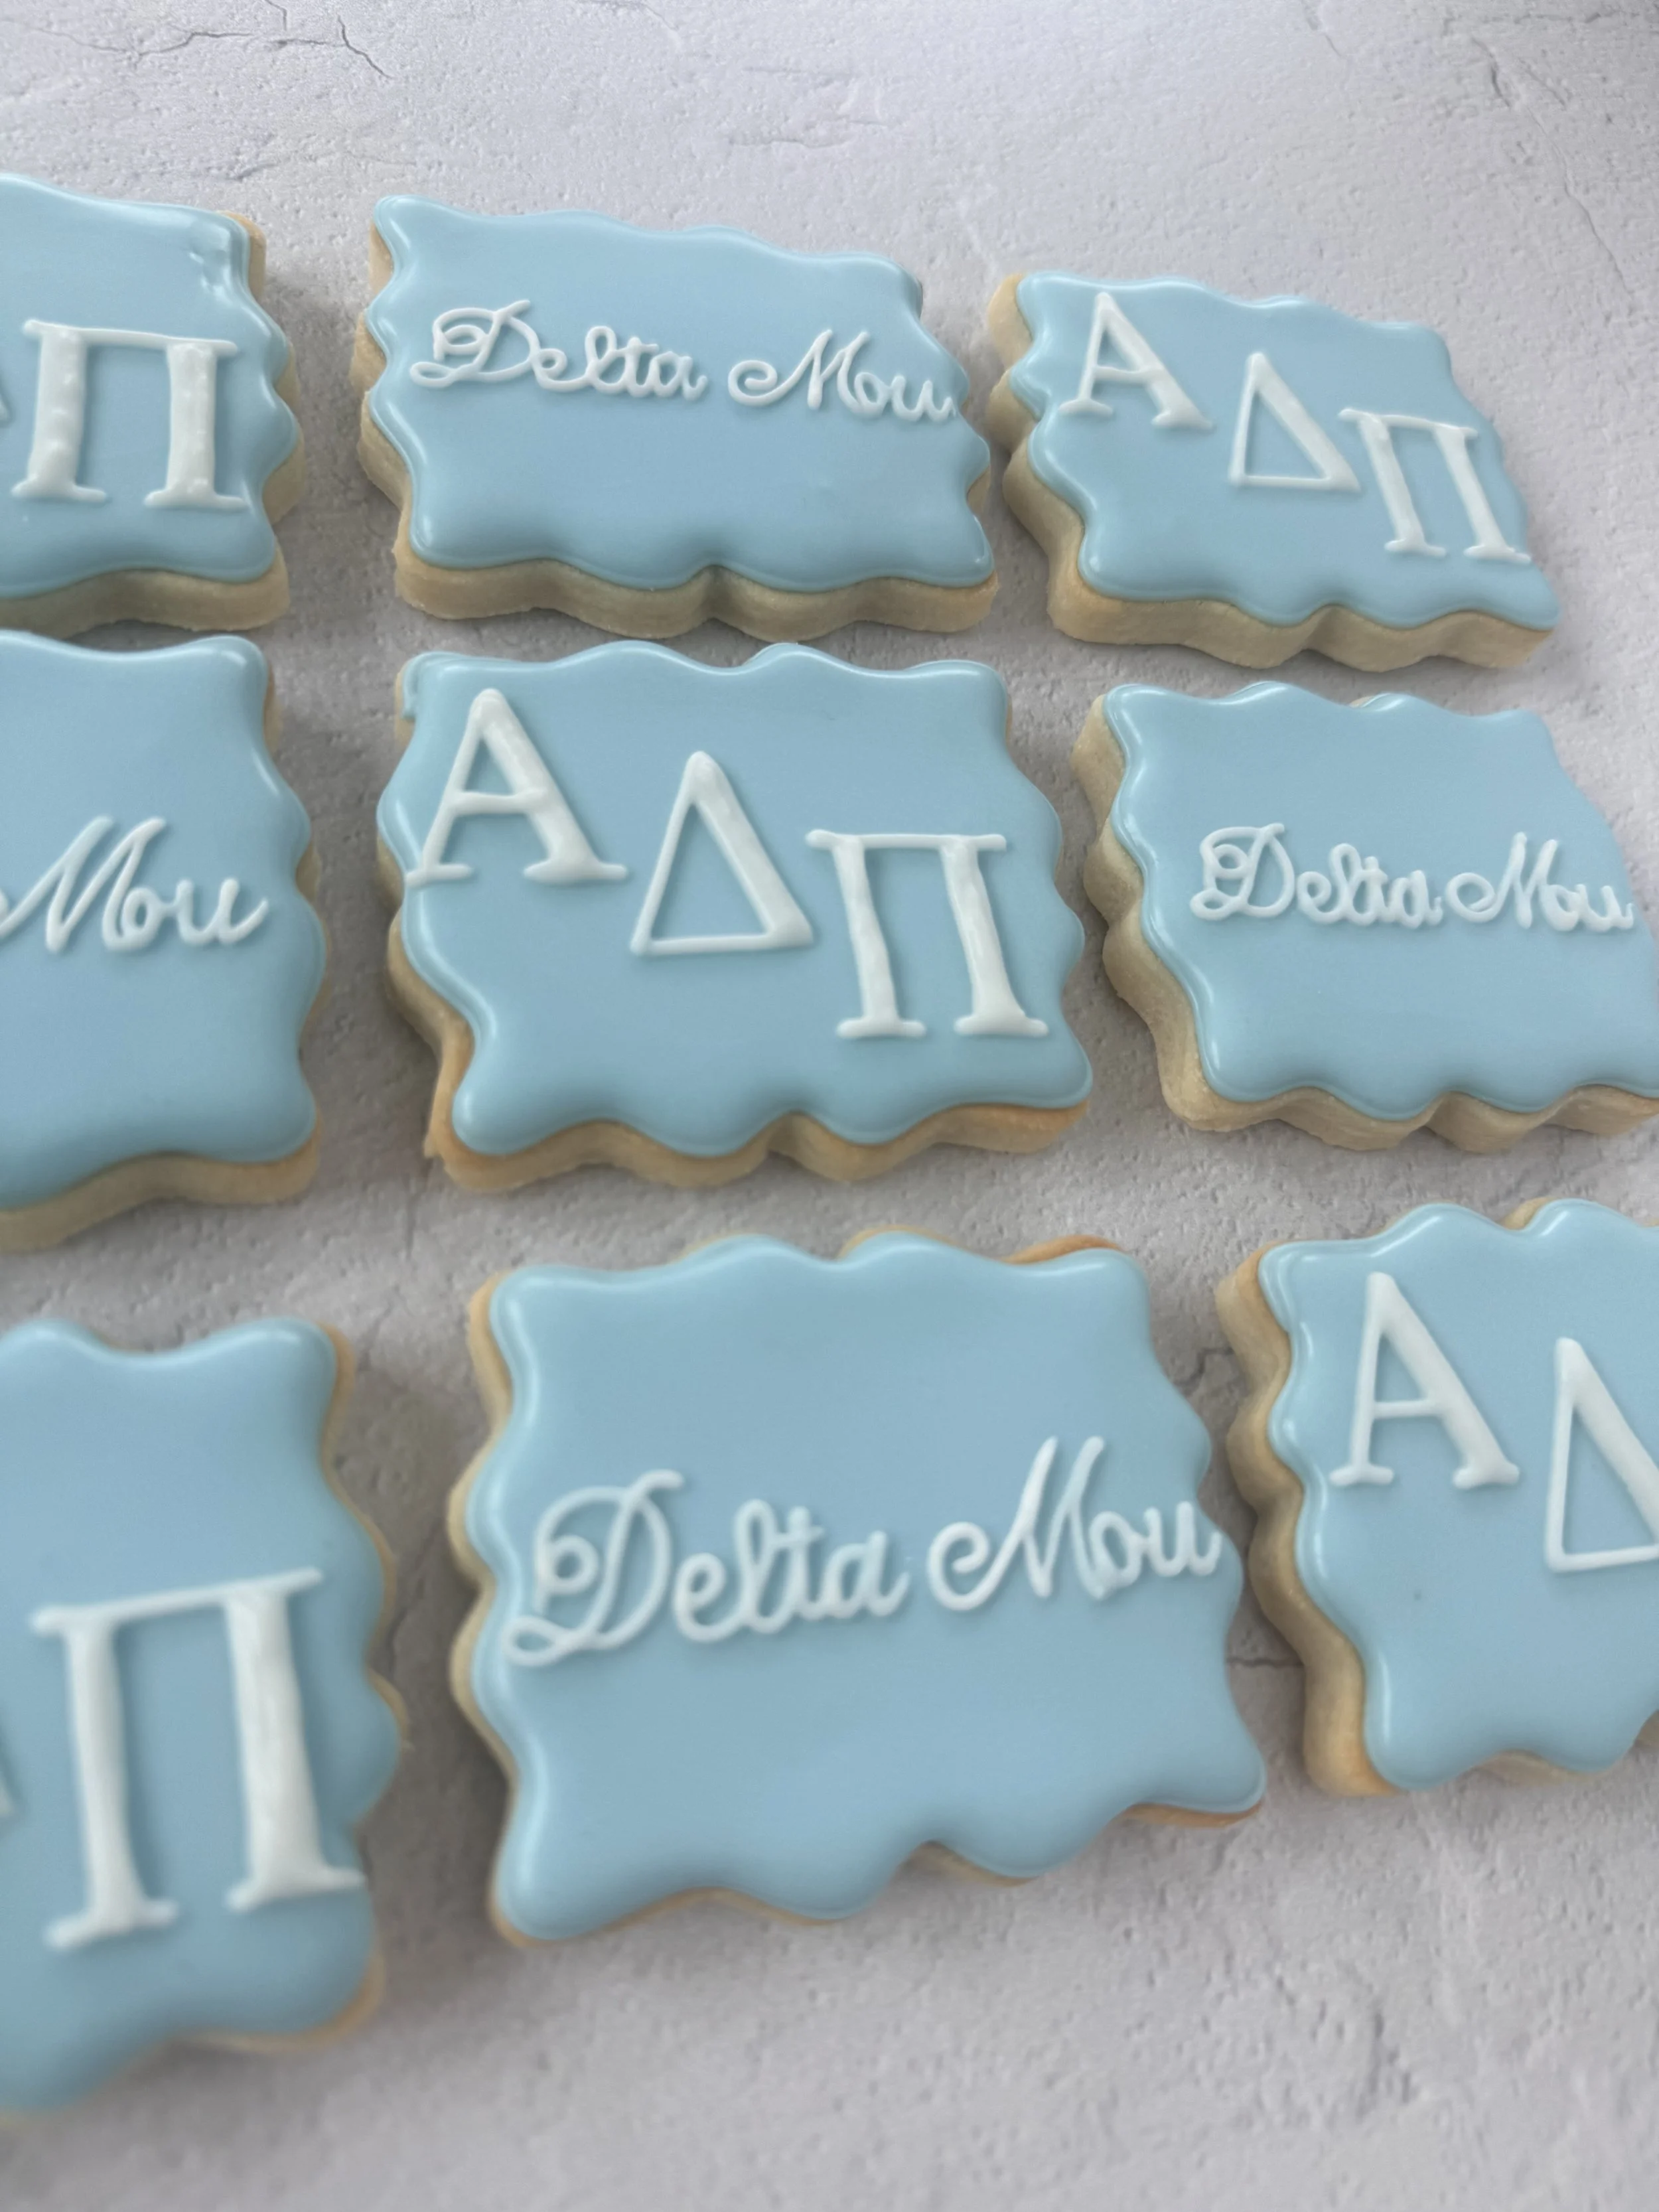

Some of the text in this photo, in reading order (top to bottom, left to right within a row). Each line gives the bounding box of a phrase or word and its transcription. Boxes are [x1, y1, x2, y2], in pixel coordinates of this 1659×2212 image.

[0, 319, 250, 509] Π
[409, 300, 708, 400] Delta
[1189, 822, 1443, 929] Delta
[500, 1469, 912, 1666] Delta
[0, 1566, 367, 1952] Π
